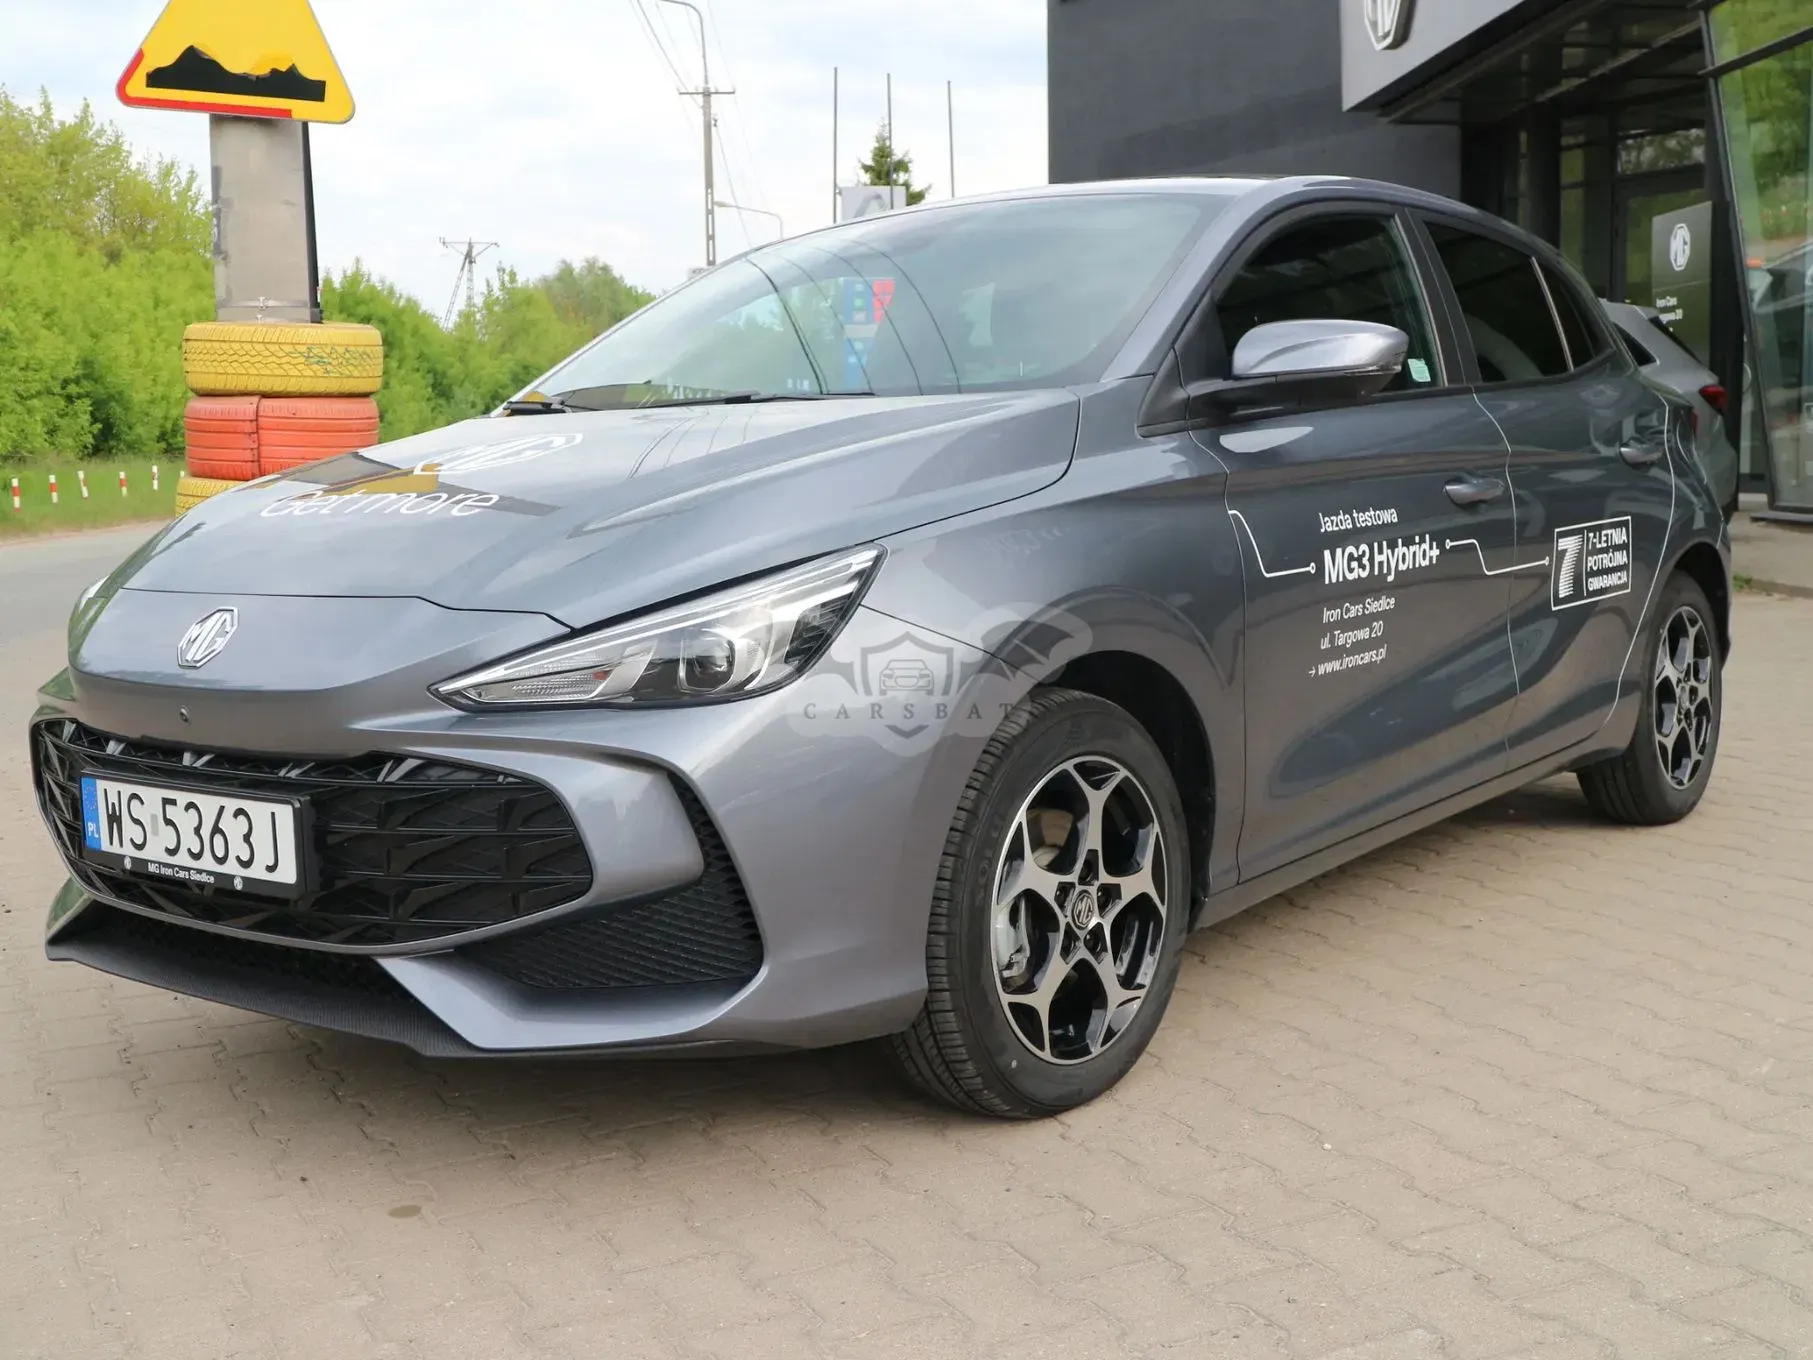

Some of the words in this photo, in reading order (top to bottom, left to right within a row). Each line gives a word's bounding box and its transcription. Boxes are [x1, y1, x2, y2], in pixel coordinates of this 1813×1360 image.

[261, 489, 366, 517] Get
[343, 493, 500, 516] more
[1319, 509, 1353, 533] Jazda
[1353, 507, 1398, 528] testowa
[1588, 527, 1628, 550] 7-LETNIA
[1323, 543, 1370, 584] MG3
[1373, 534, 1440, 582] Hybrid+
[1558, 534, 1583, 598] 7
[1587, 549, 1628, 572] POTRÓJNA
[1587, 570, 1628, 591] GWARANCJA
[1323, 607, 1341, 624] Iron
[1343, 603, 1363, 619] Cars
[1364, 595, 1396, 614] Siedlce
[180, 609, 237, 665] MG
[1320, 632, 1331, 650] ul.
[1334, 627, 1370, 648] Targowa
[1371, 620, 1384, 638] 20
[1318, 643, 1387, 675] www.ironcars.pl
[87, 822, 99, 838] PL
[104, 788, 148, 851] WS
[161, 797, 279, 873] 5363J
[147, 862, 159, 874] MG
[160, 865, 173, 876] Iron
[174, 867, 189, 879] Cars
[189, 870, 215, 884] Siedlce
[1075, 894, 1094, 926] MG
